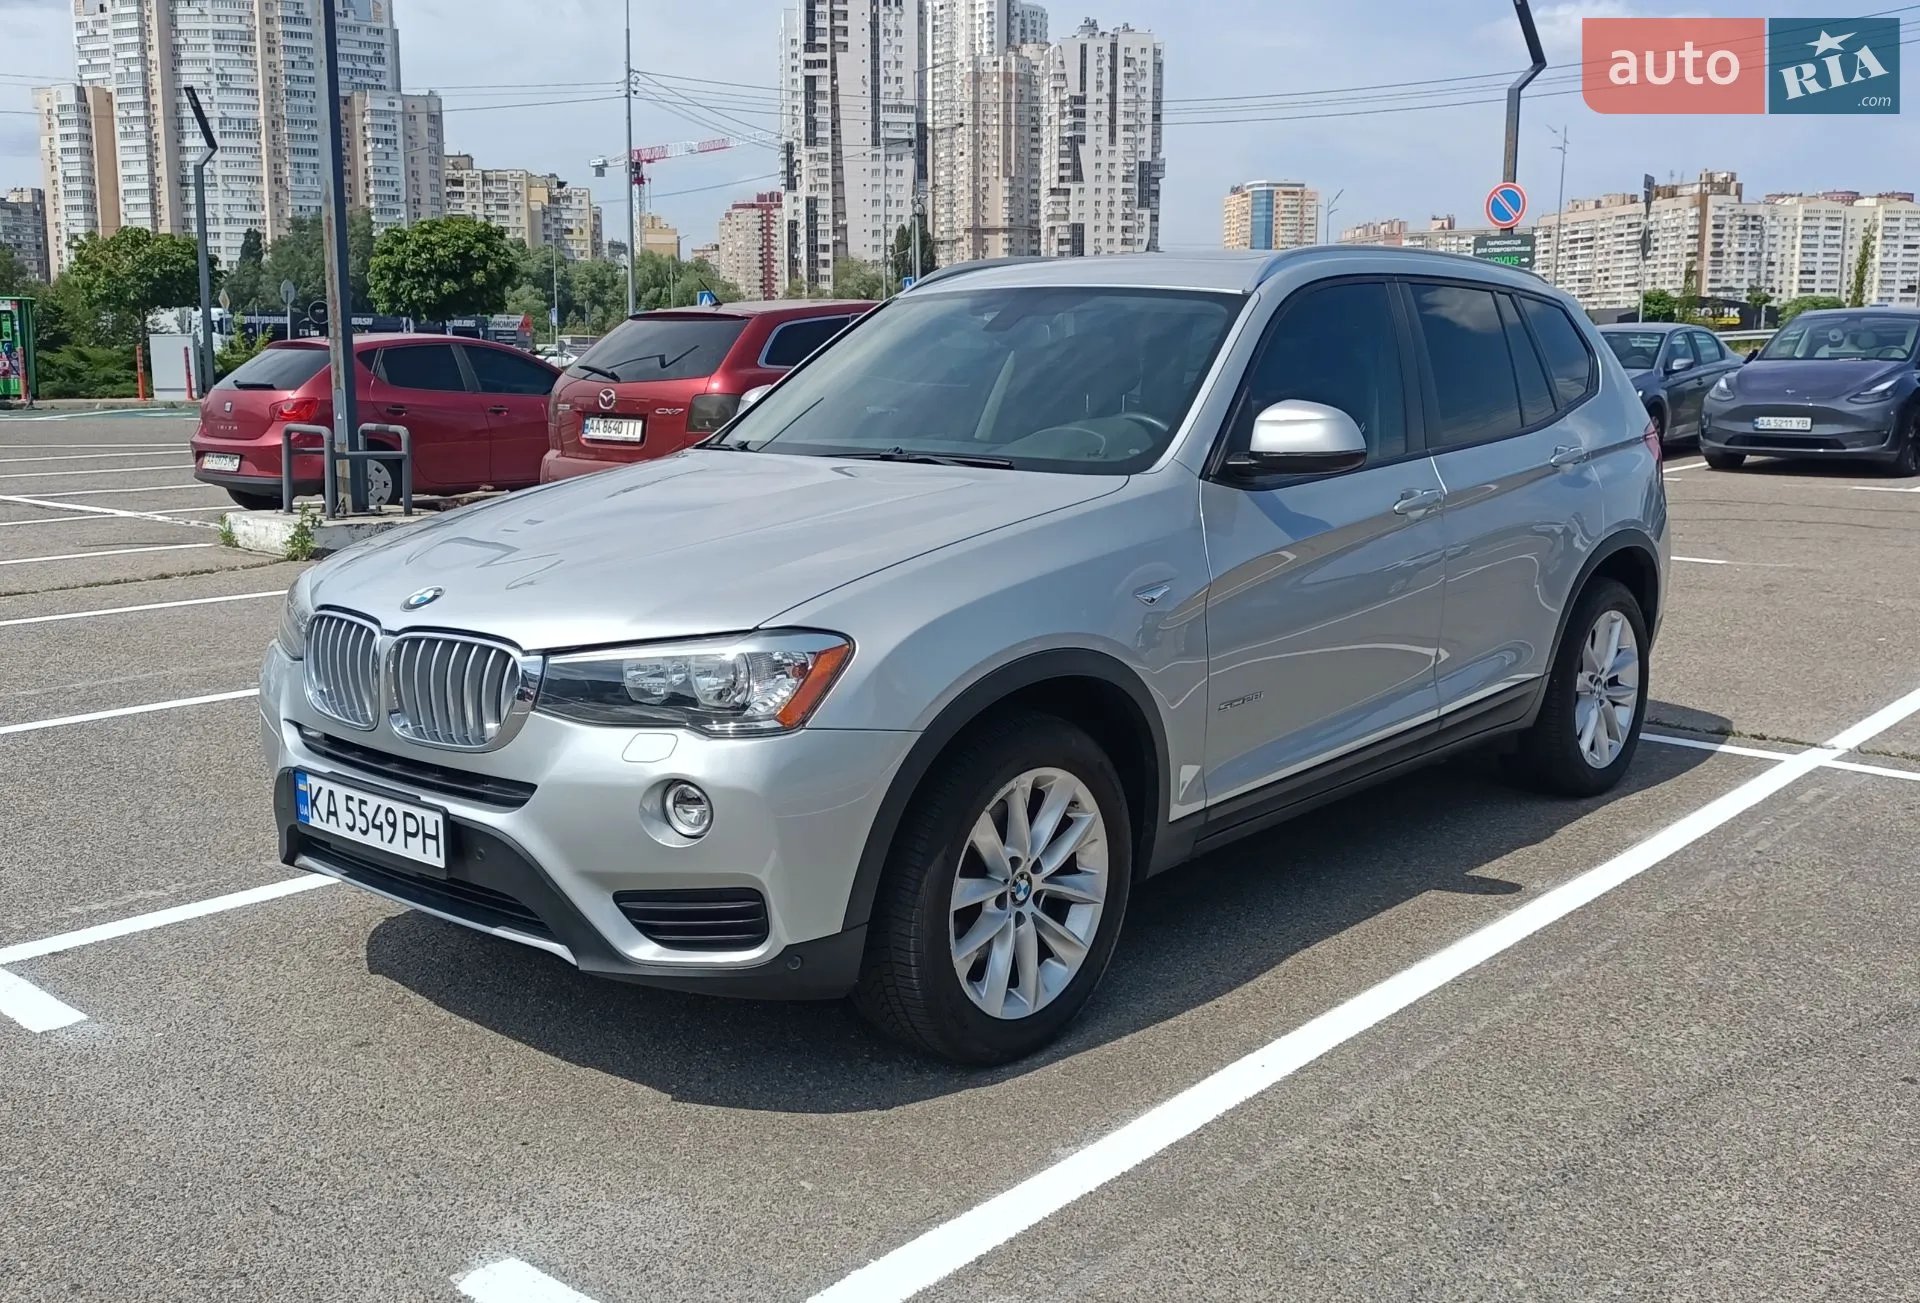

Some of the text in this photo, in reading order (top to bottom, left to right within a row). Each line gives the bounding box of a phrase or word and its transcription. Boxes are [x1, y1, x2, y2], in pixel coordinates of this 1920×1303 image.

[602, 420, 624, 434] 8640
[299, 804, 308, 816] UA
[308, 783, 440, 858] KA 5549 PH
